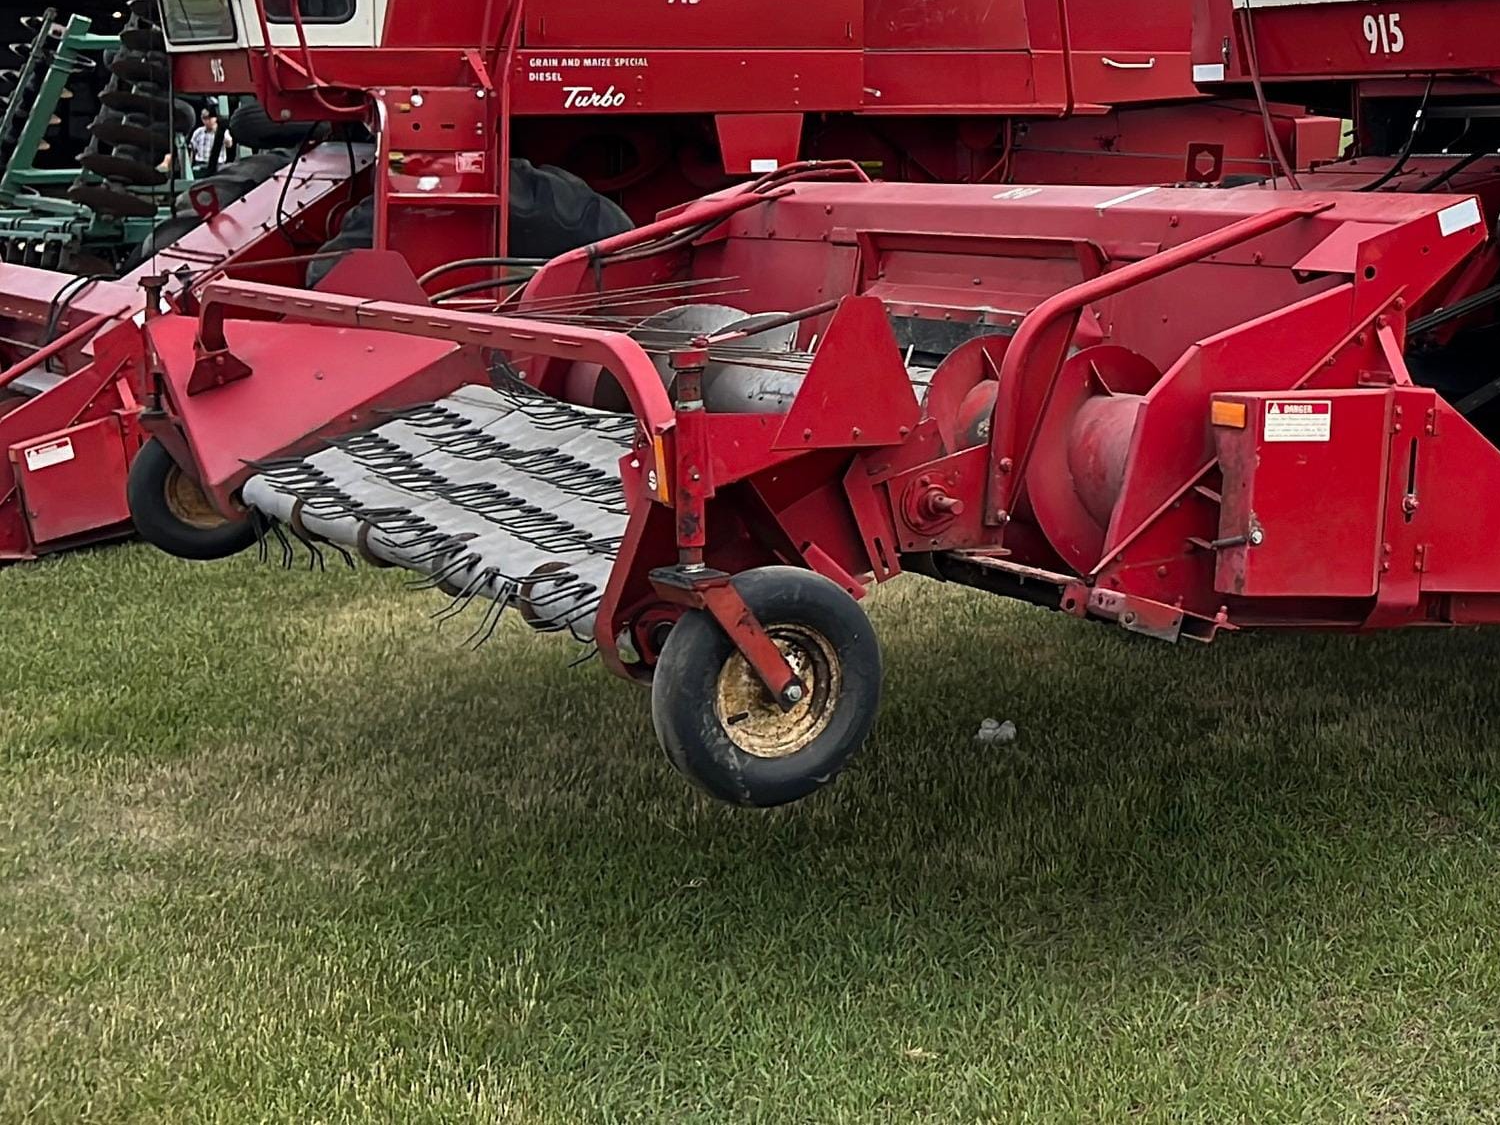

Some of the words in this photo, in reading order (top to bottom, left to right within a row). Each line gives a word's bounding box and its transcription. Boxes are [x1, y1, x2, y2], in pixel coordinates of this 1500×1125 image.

[1363, 12, 1405, 54] 915
[529, 58, 559, 67] GRAIN
[561, 58, 581, 67] AND
[583, 58, 611, 67] MAIZE
[614, 57, 649, 67] SPECIAL
[528, 72, 563, 82] DIESEL
[562, 85, 626, 109] Turbo
